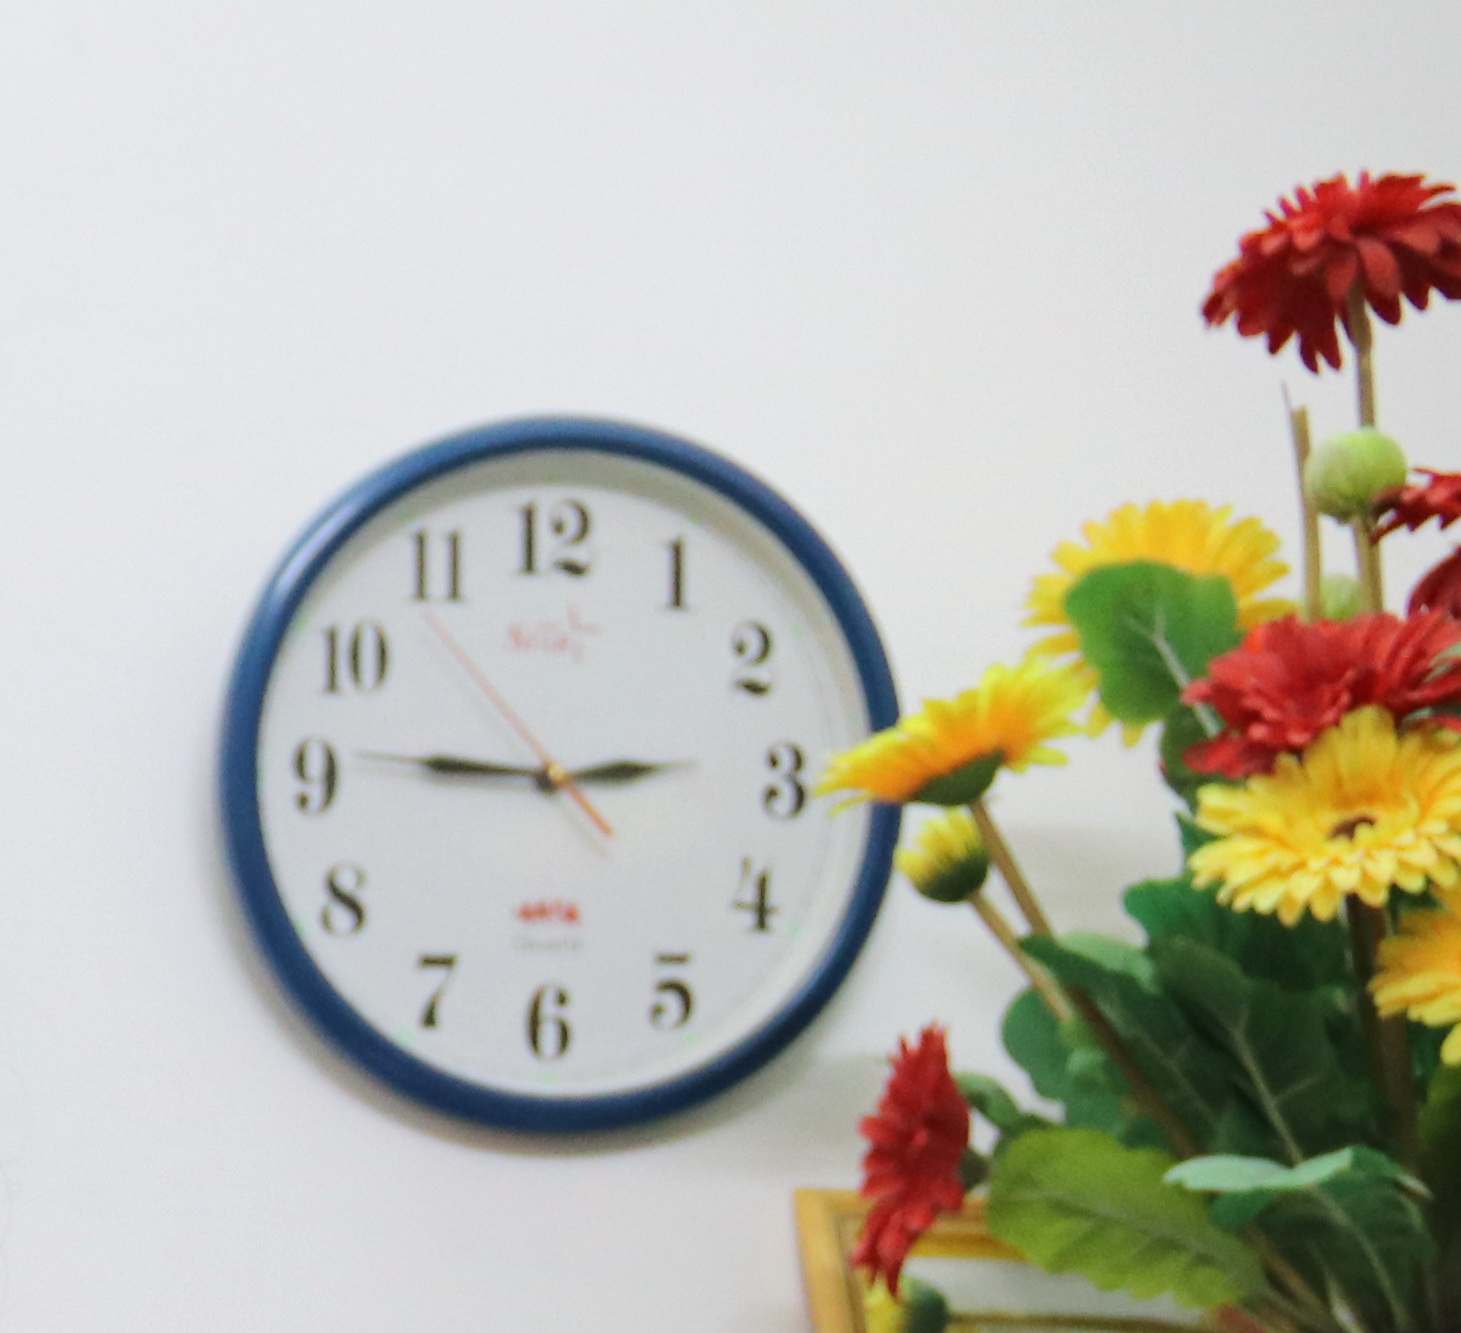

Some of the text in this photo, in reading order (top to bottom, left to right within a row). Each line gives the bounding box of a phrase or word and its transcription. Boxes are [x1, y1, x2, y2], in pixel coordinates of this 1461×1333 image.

[412, 529, 463, 602] 11
[516, 500, 592, 578] 12
[662, 536, 690, 611] 1
[320, 621, 390, 695] 10
[731, 621, 773, 697] 2
[293, 738, 341, 816] 9
[763, 741, 807, 820] 3
[320, 864, 366, 936] 8
[732, 857, 779, 933] 4
[416, 953, 457, 1029] 7
[526, 984, 571, 1060] 6
[649, 951, 693, 1031] 5
